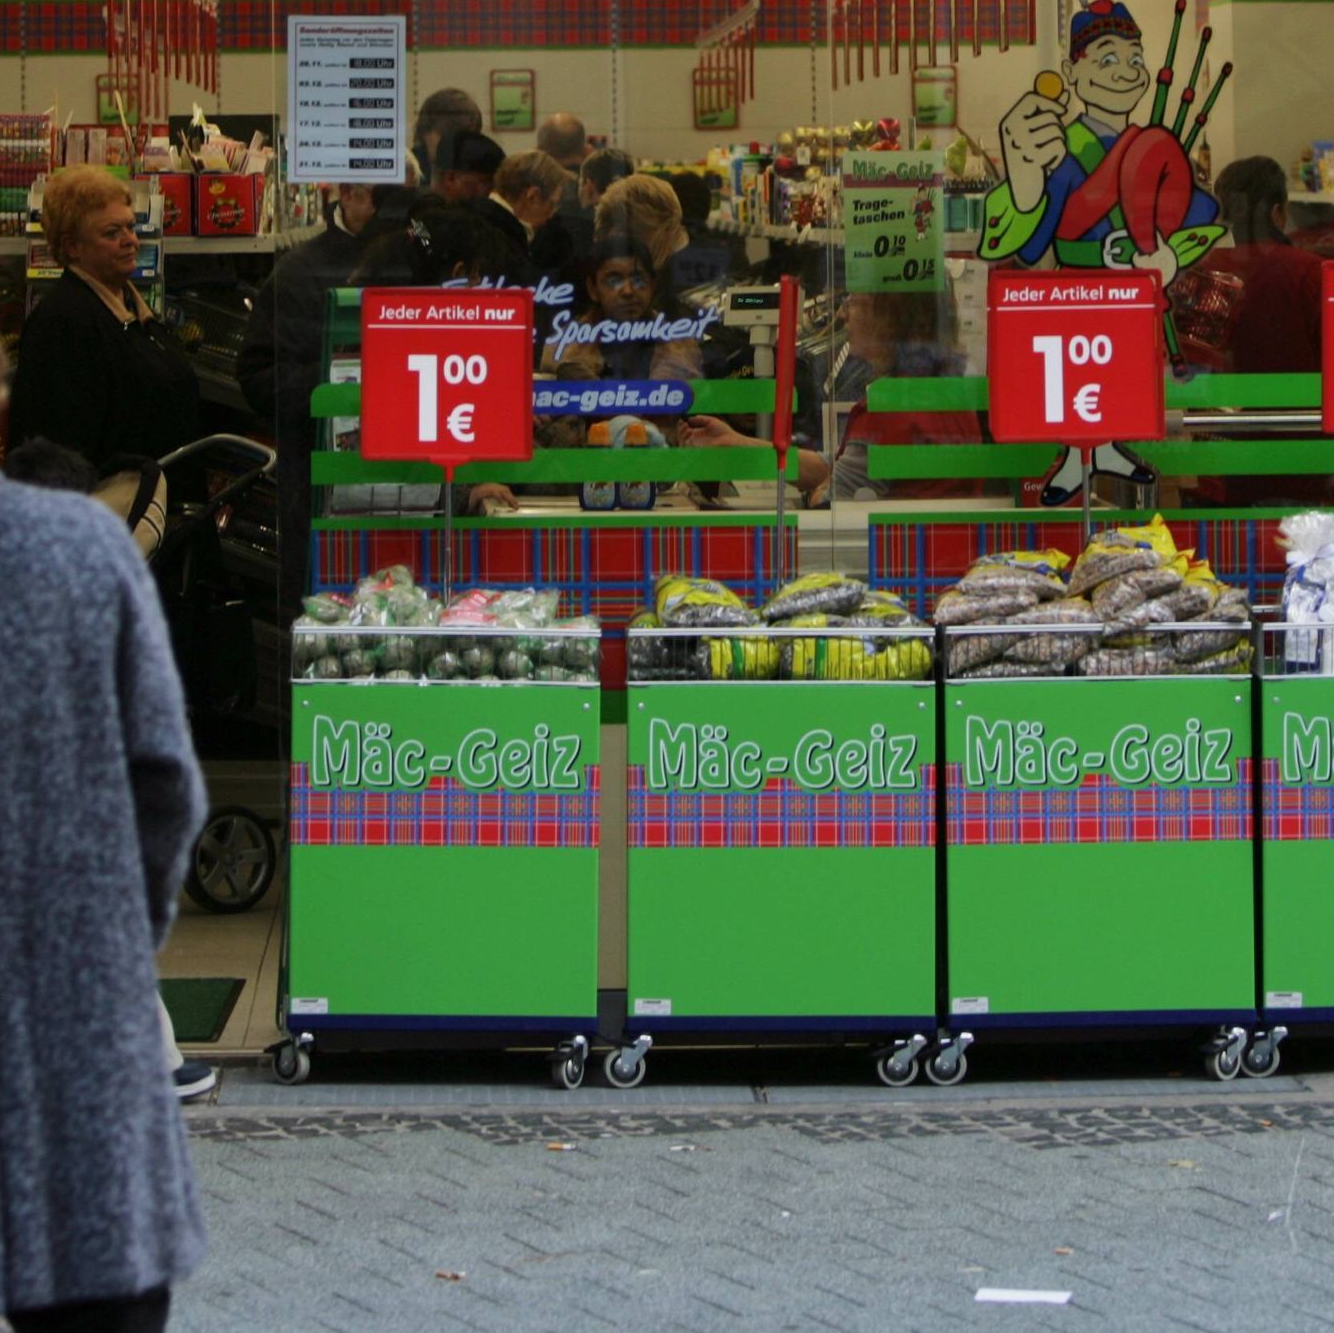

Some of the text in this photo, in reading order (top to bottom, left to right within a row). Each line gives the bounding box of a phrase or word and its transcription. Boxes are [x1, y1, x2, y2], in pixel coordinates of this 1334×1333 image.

[852, 199, 893, 212] Trage-
[853, 210, 905, 225] taschen
[379, 305, 516, 321] Jeder Artikel nur
[1003, 286, 1139, 302] Jeder Artikel nur
[545, 306, 719, 361] Sparsamkeit
[532, 384, 684, 413] ac-geiz.de
[1073, 383, 1102, 423] €
[446, 403, 475, 443] €
[312, 713, 583, 789] Mäc-Geiz
[648, 716, 918, 791] Mäc-Geiz
[964, 713, 1233, 787] Mäc-Geiz
